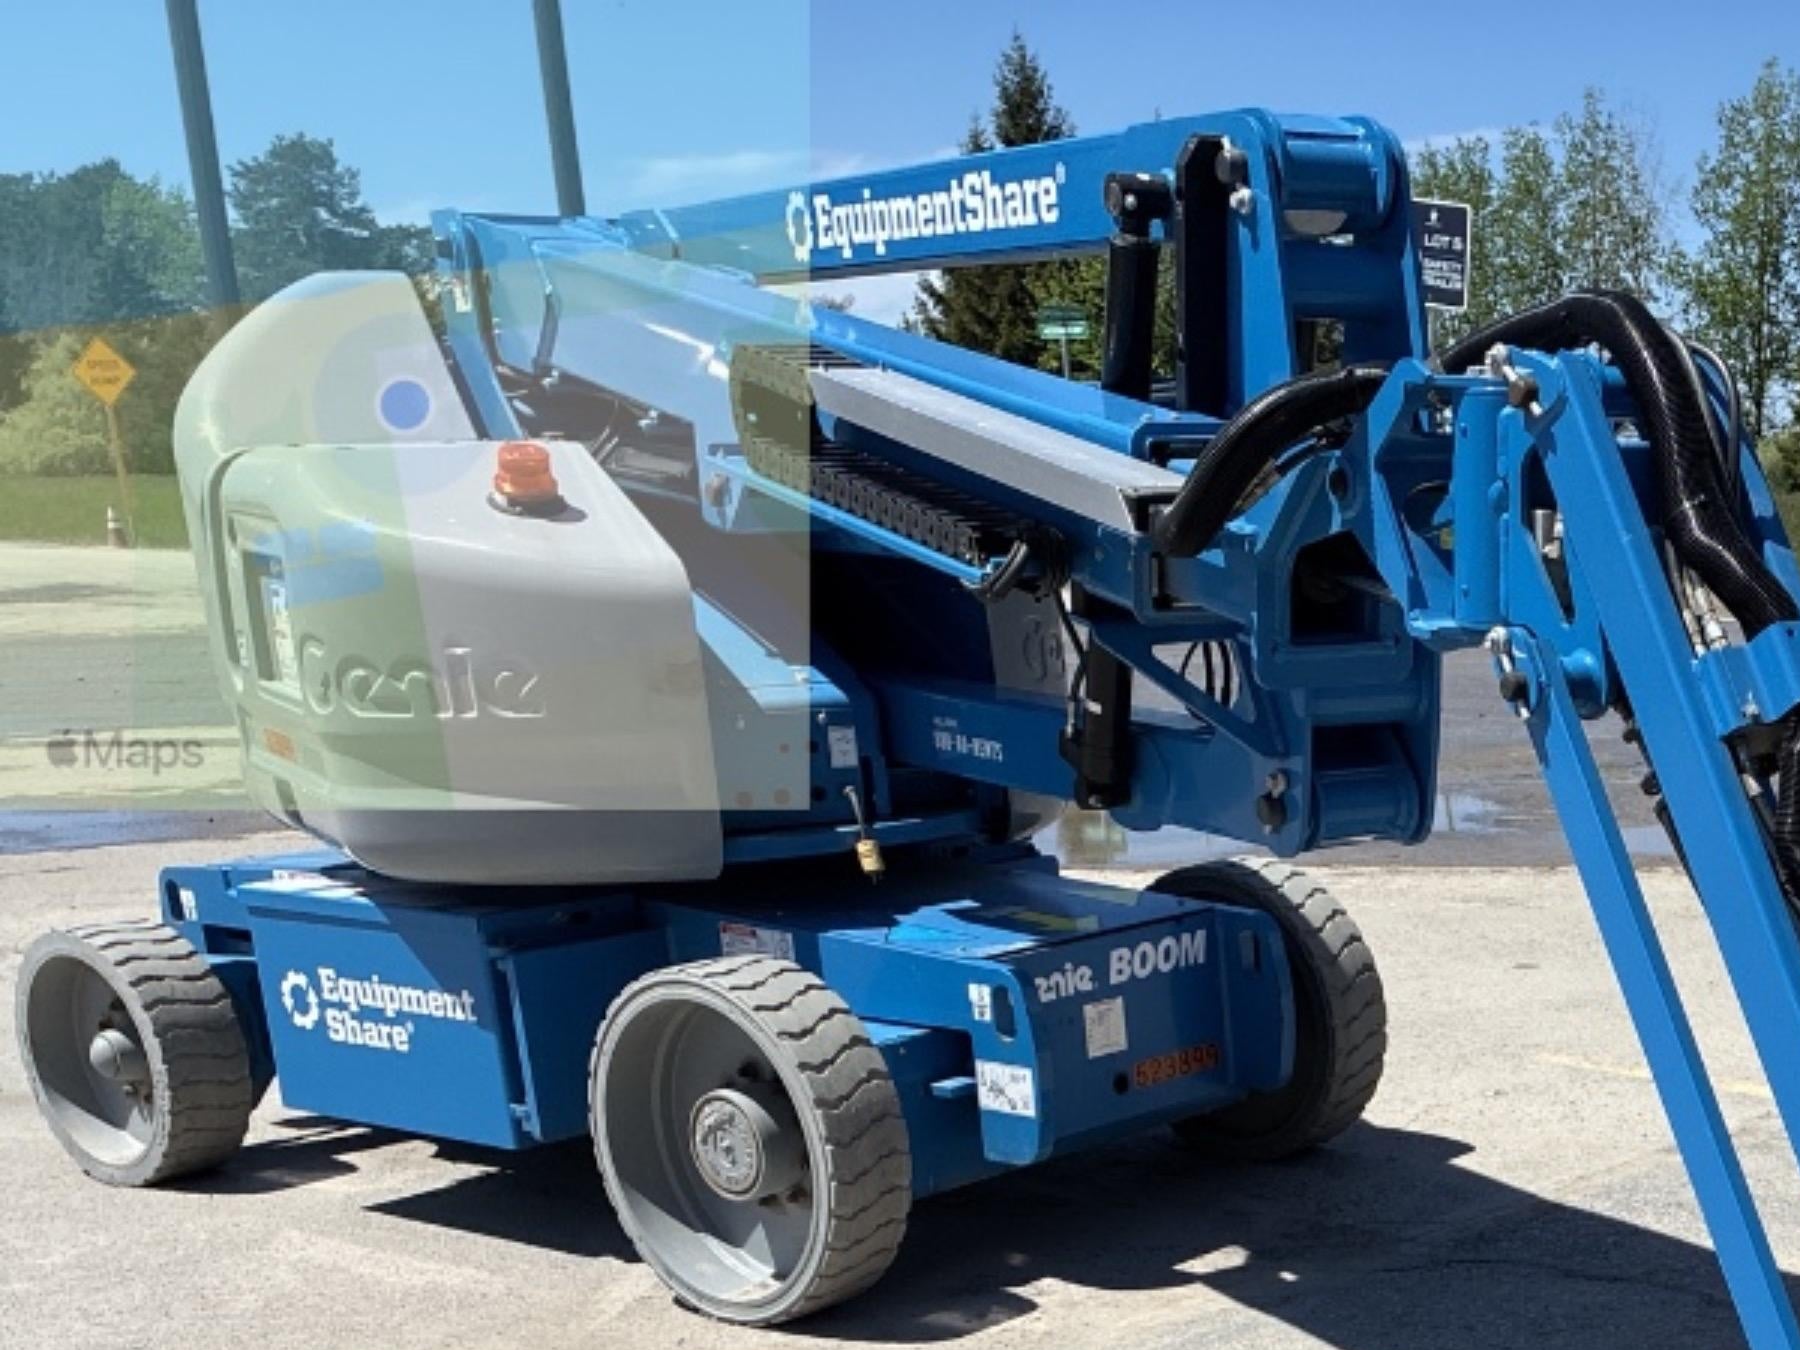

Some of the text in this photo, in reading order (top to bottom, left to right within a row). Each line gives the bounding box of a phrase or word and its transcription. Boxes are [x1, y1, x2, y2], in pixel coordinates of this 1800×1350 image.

[813, 170, 1060, 259] EquipmentShare
[1109, 929, 1207, 985] BOOM
[317, 966, 478, 1020] Equipment
[325, 1007, 410, 1053] Share
